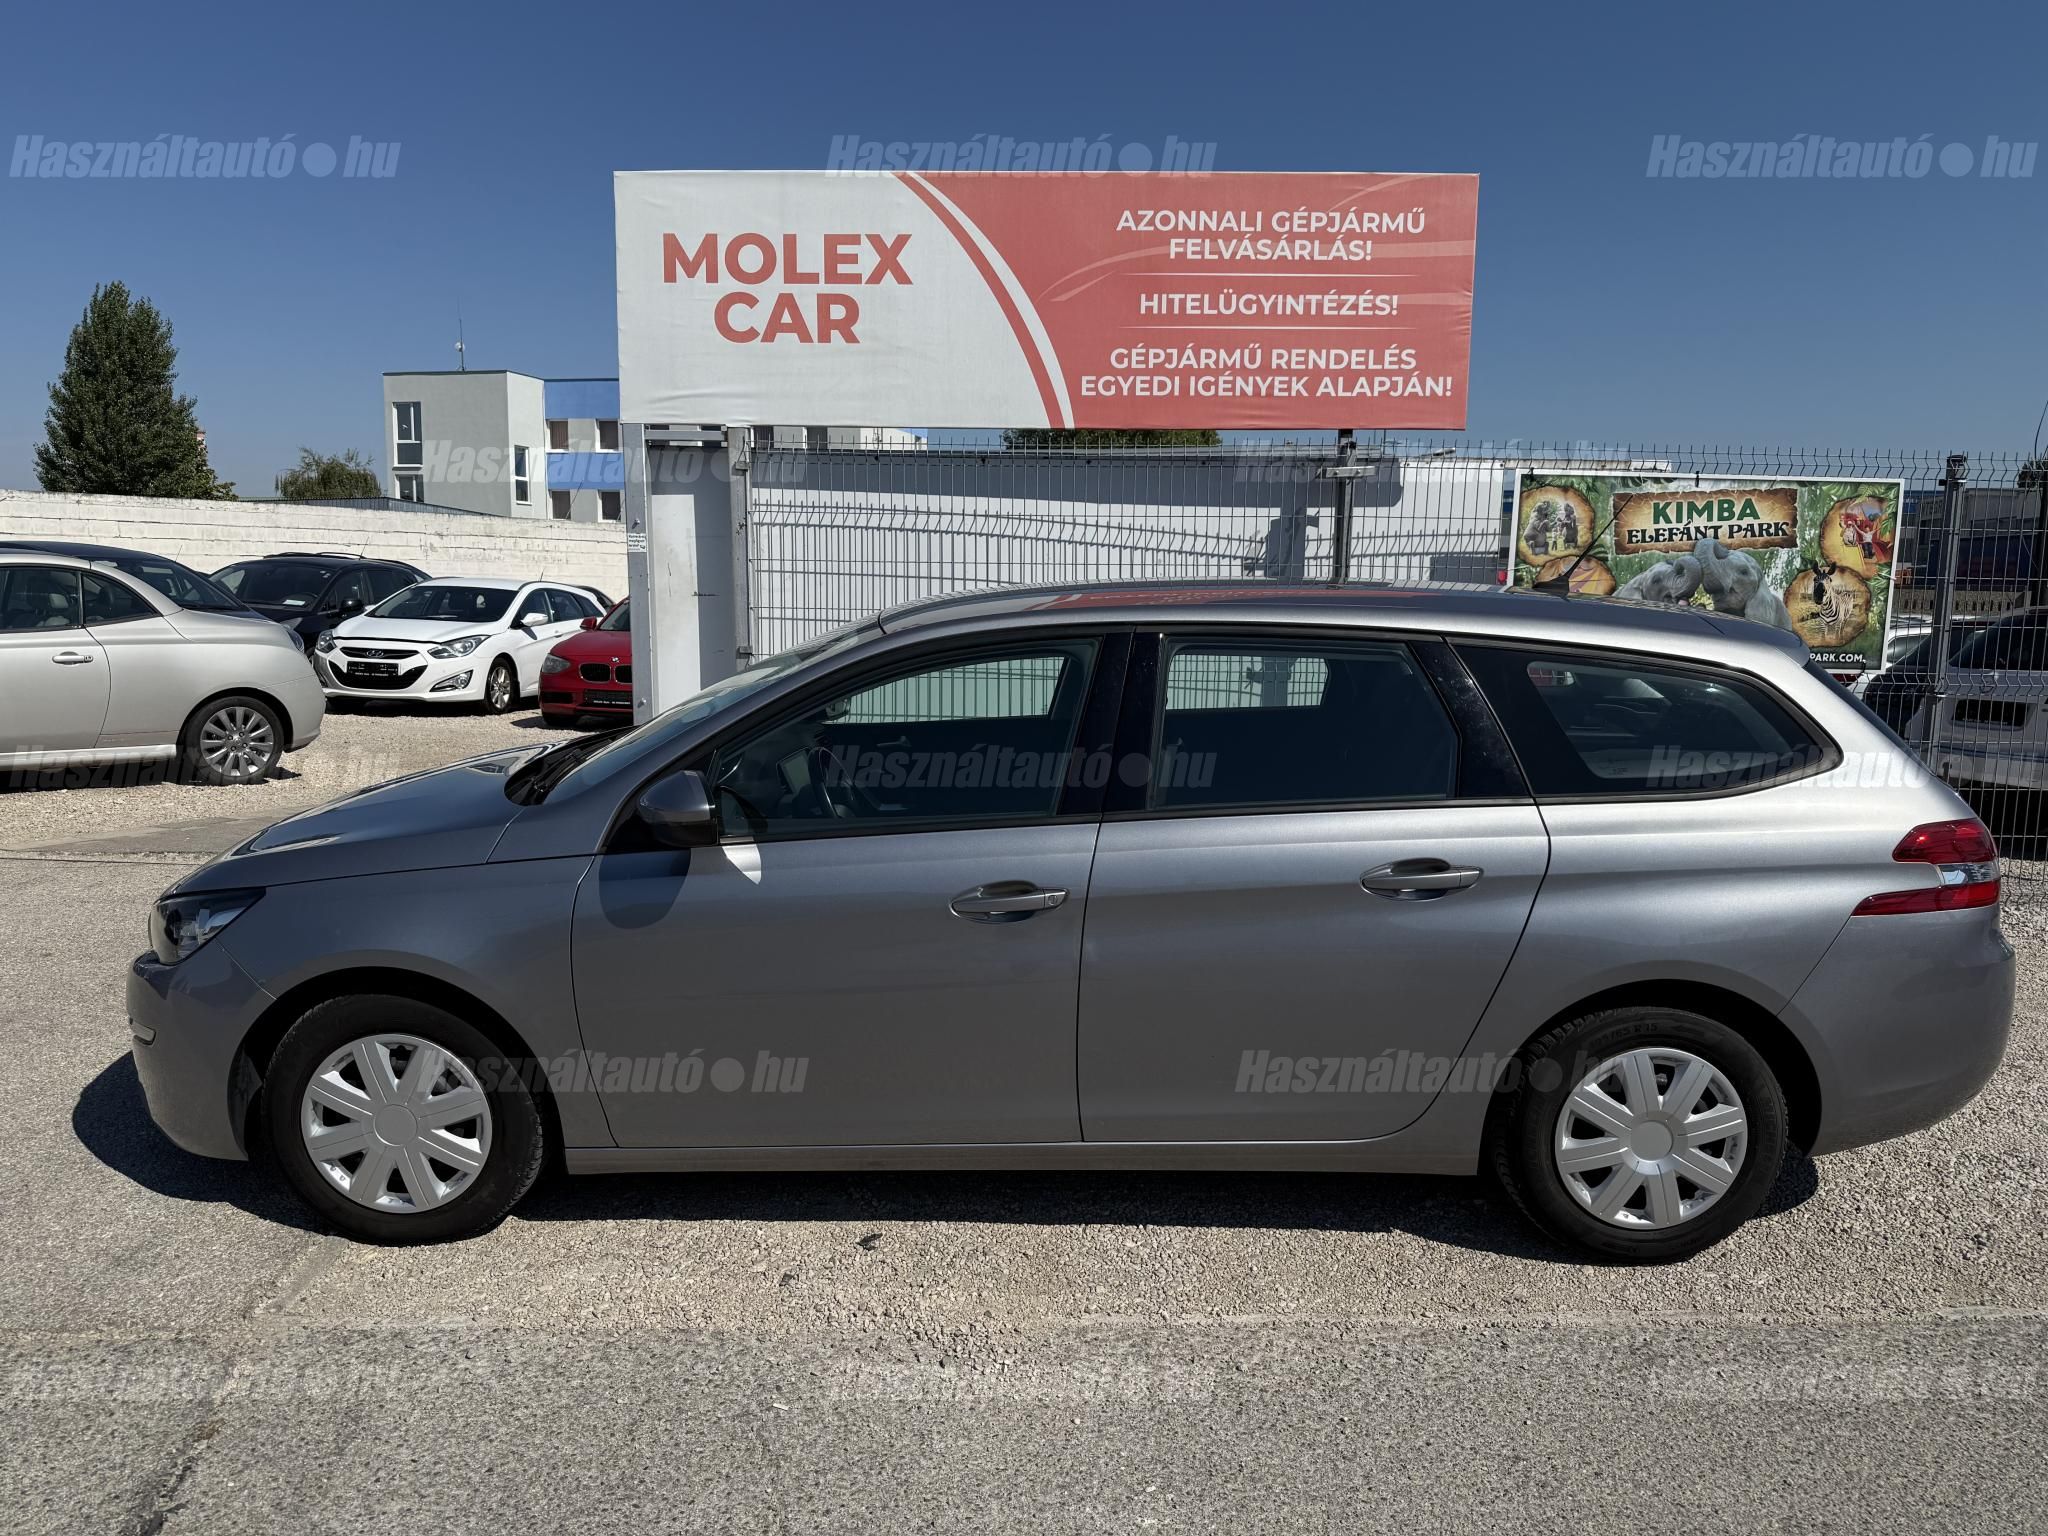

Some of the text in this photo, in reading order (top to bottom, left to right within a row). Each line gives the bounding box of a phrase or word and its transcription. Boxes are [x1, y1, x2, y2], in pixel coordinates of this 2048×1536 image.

[1116, 206, 1426, 234] AZONNALI GÉPJÁRMŰ
[662, 232, 914, 285] MOLEX
[1169, 234, 1373, 261] FELVÁSÁRLÁS!
[1139, 288, 1399, 316] HITELÜGYINTÉZÉS!
[713, 291, 861, 344] CAR
[1109, 343, 1417, 371] GÉPJÁRMŰ RENDELÉS
[1081, 370, 1453, 398] EGYEDI IGÉNYEK ALAPJÁN!
[1652, 498, 1761, 525] KIMBA
[1626, 520, 1790, 545] ELEFÁNT PARK
